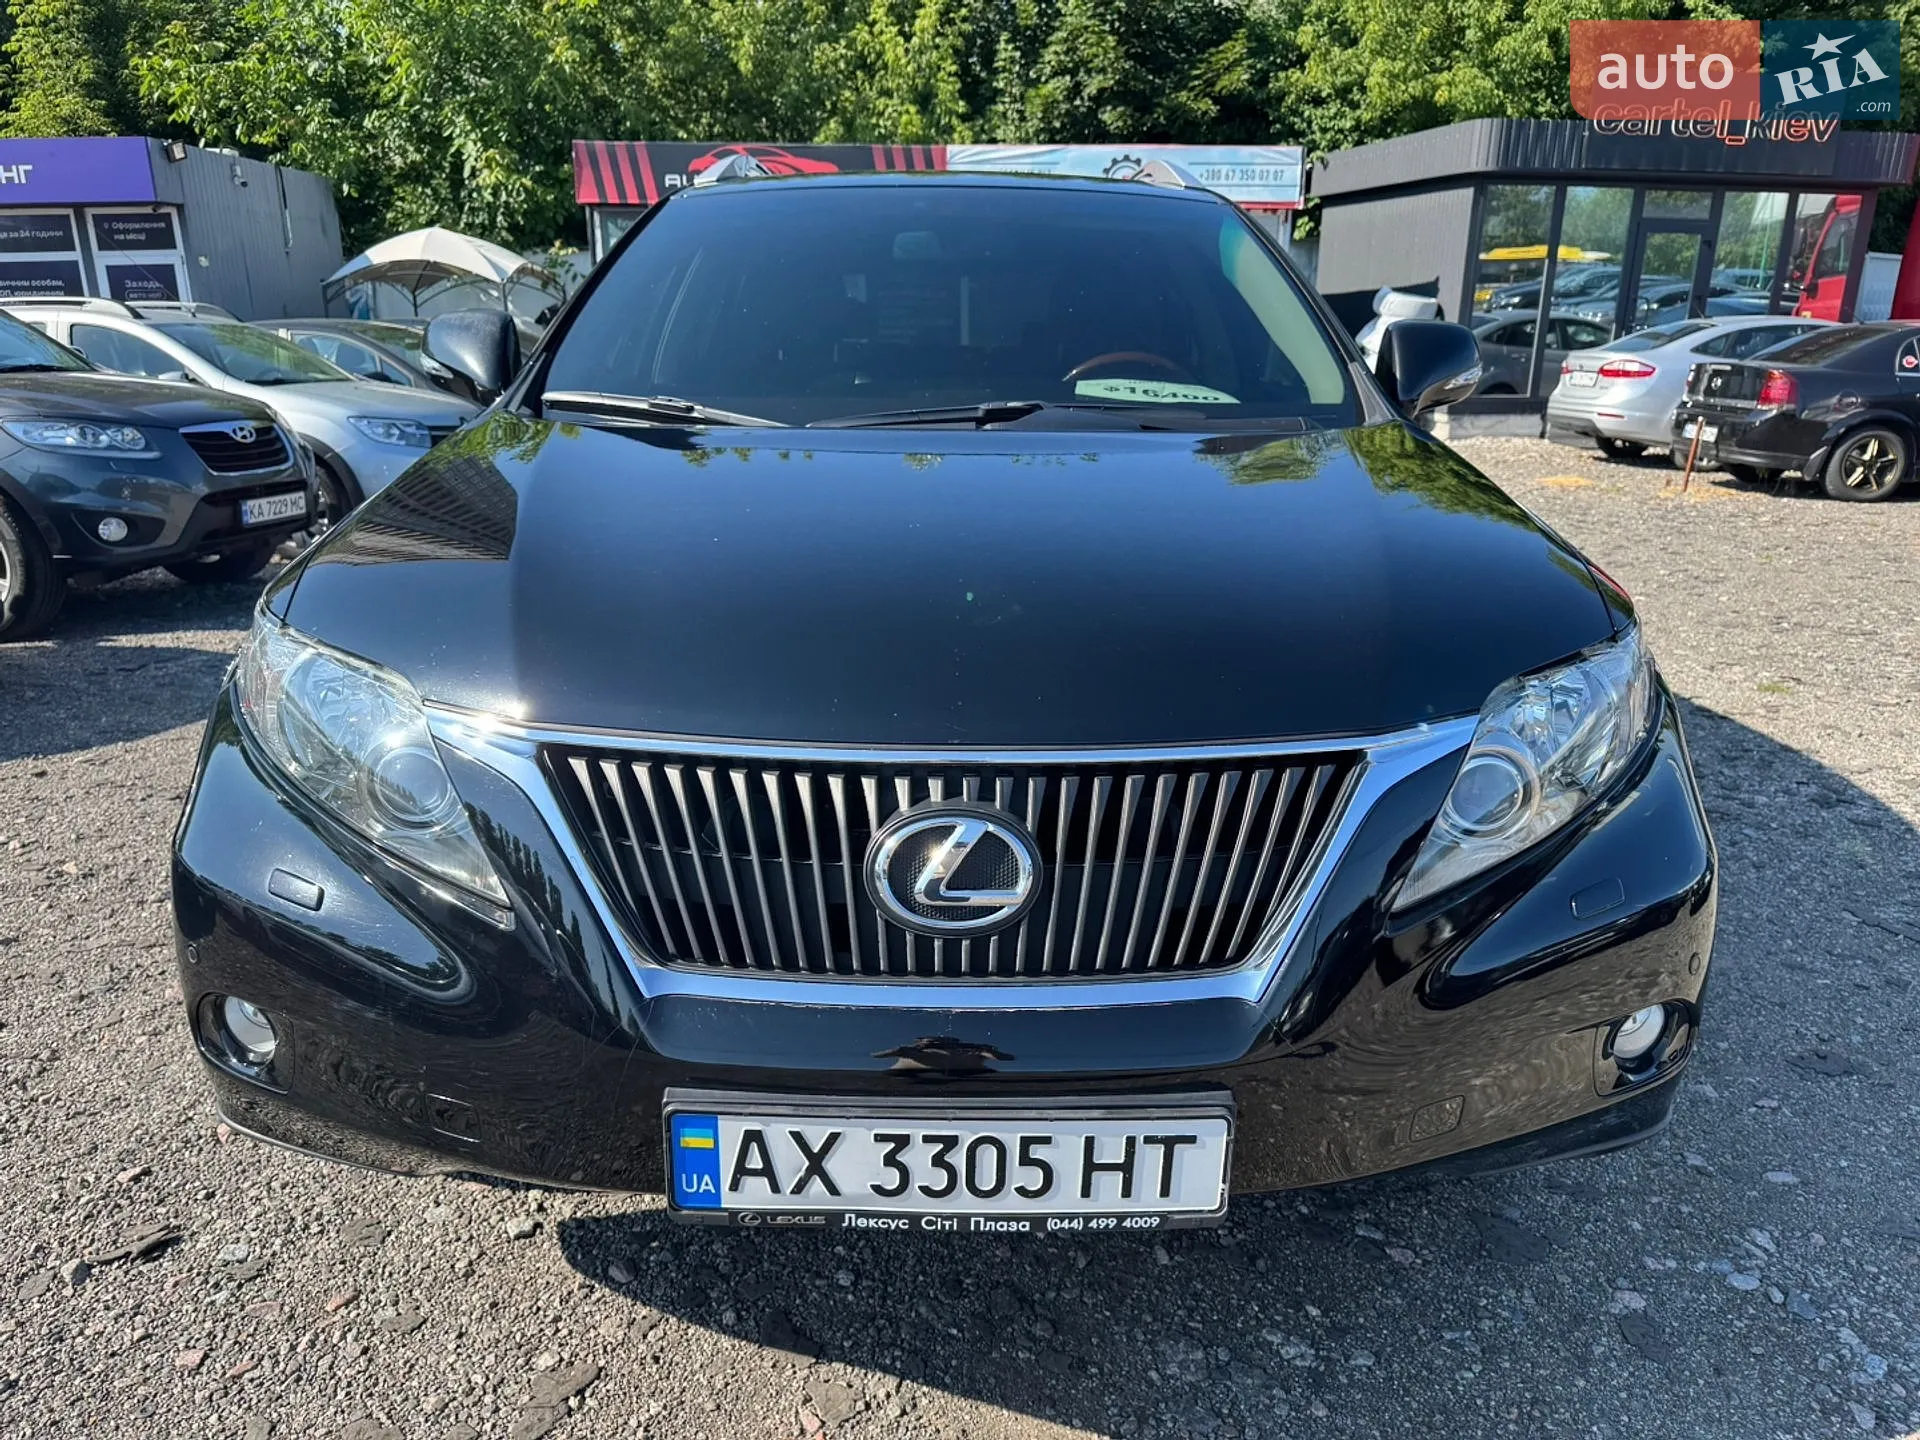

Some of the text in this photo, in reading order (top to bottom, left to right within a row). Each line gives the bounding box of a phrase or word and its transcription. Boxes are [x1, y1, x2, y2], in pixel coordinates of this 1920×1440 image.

[728, 1129, 1198, 1199] AX 3305 HT
[681, 1173, 716, 1194] UA
[766, 1215, 827, 1225] LEXUS
[841, 1213, 1160, 1232] Лексус Сіті Плаза (044) 499 4009
